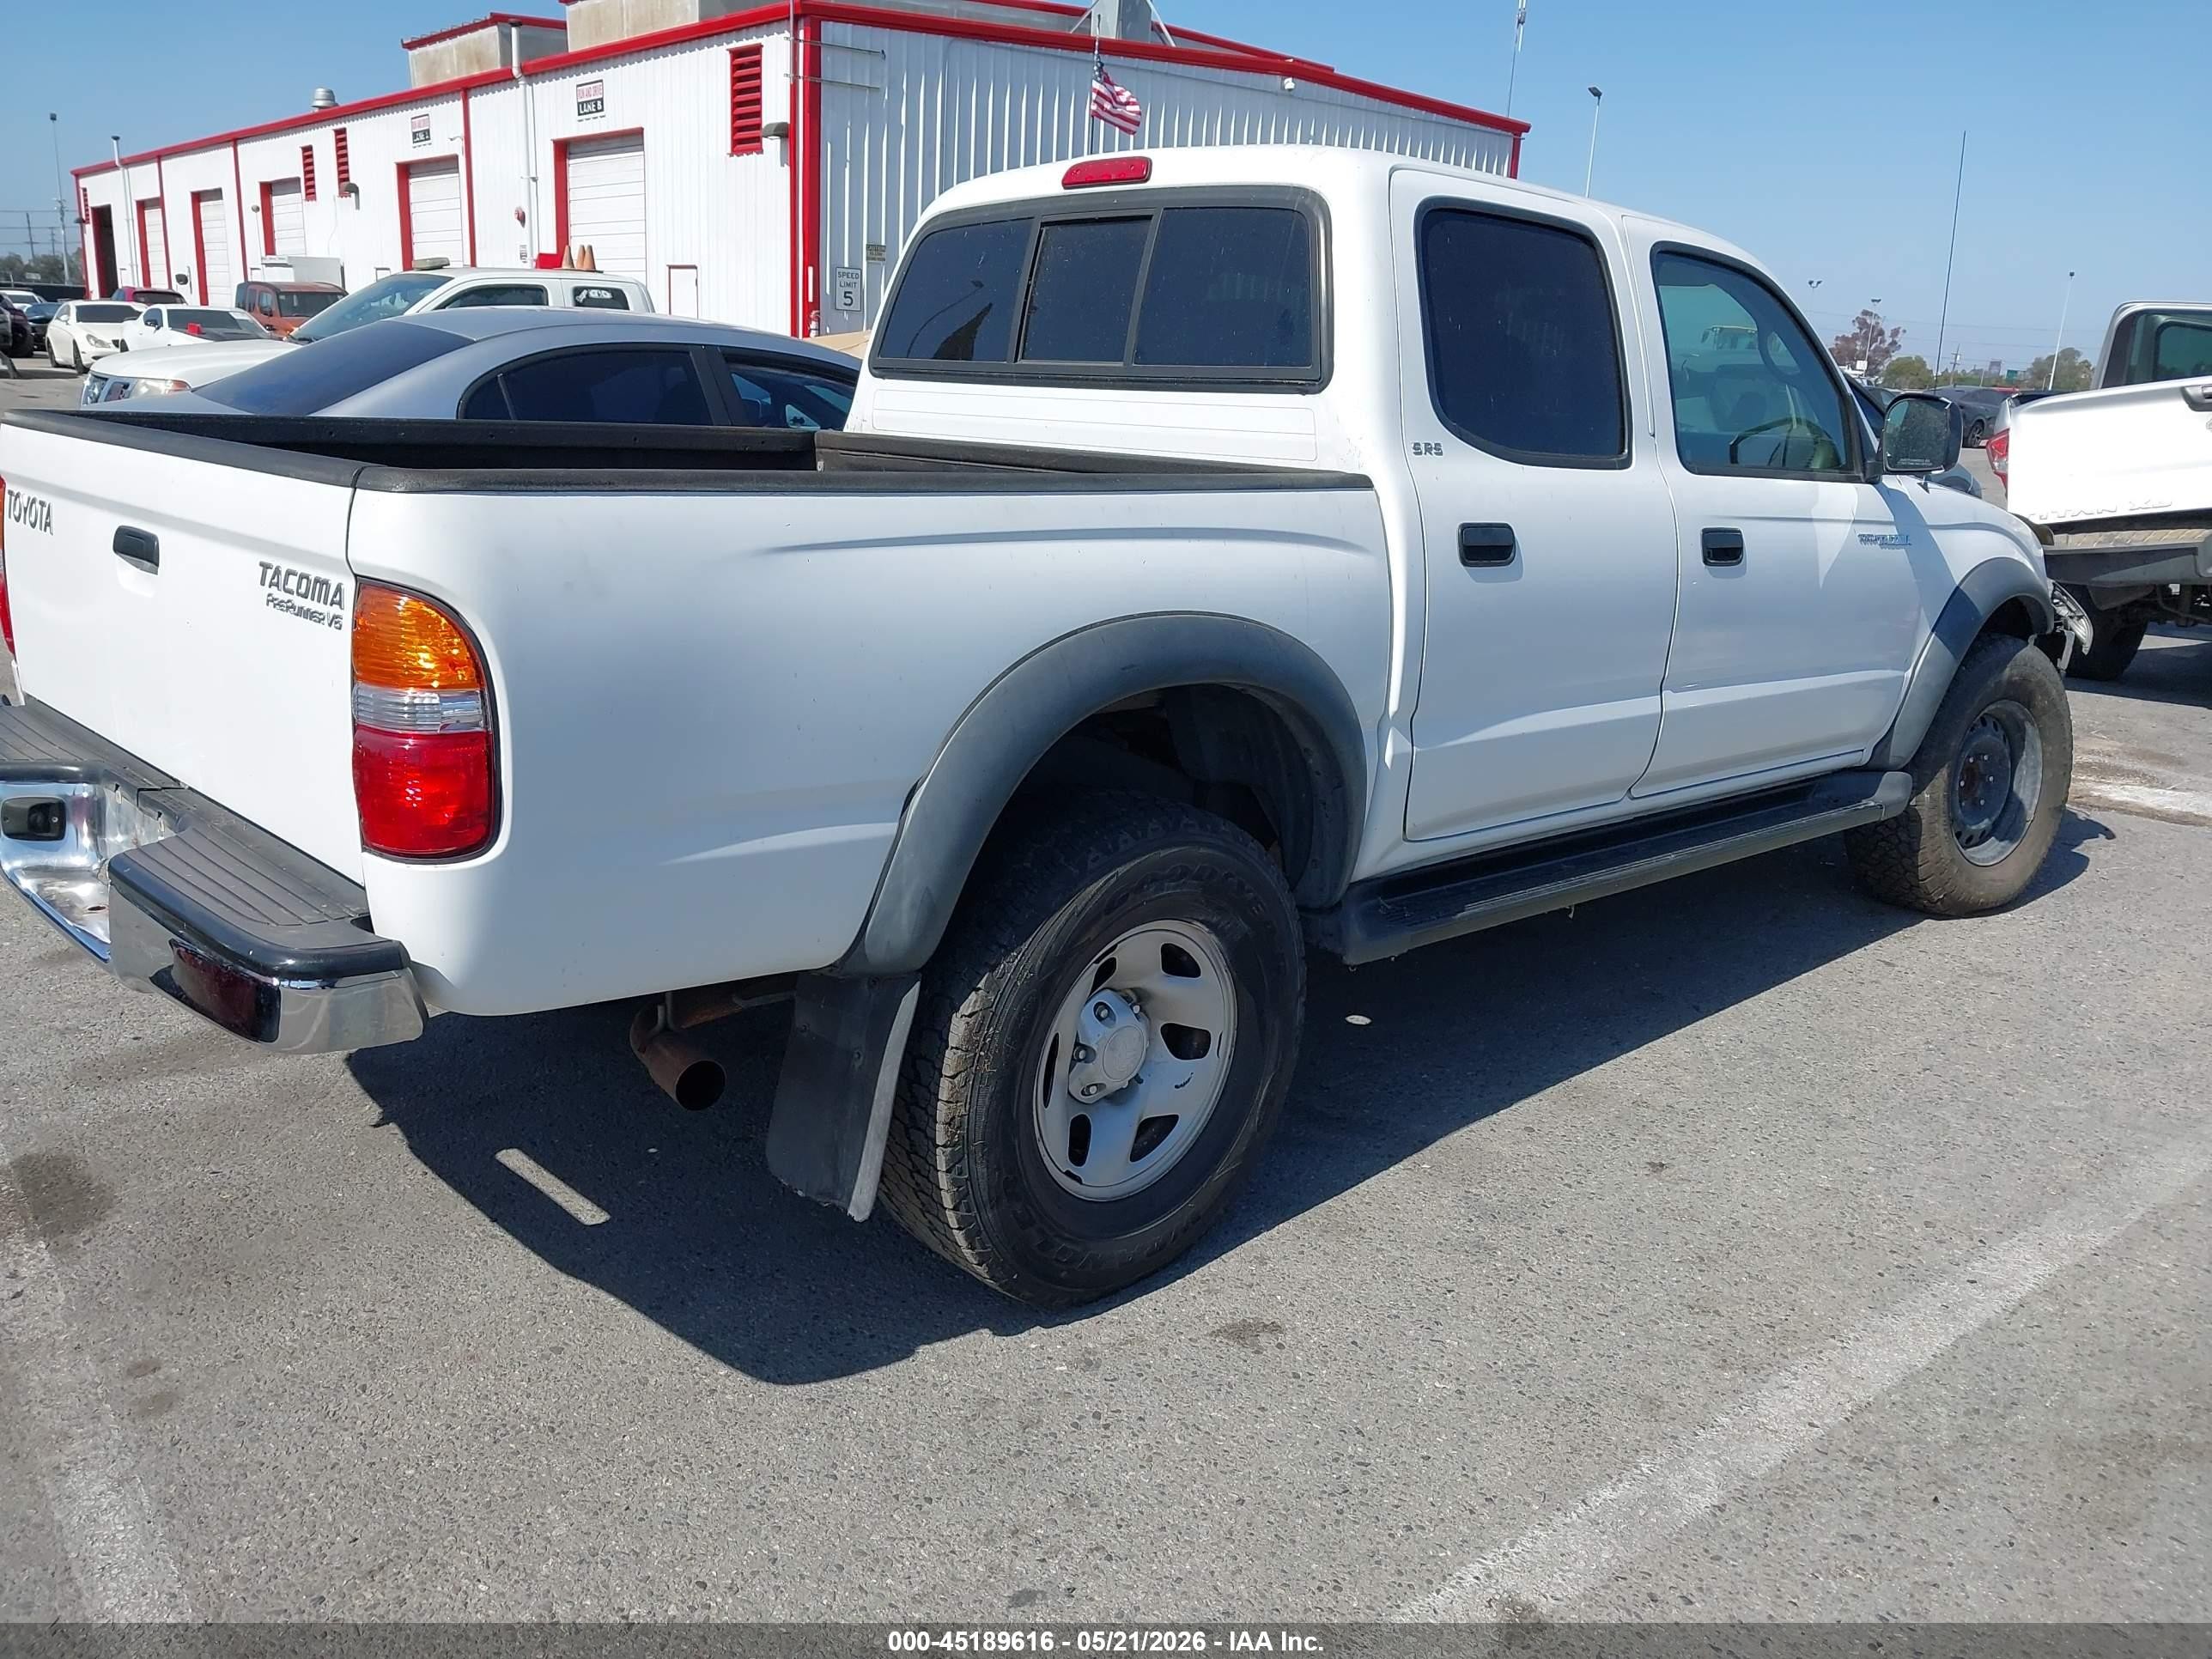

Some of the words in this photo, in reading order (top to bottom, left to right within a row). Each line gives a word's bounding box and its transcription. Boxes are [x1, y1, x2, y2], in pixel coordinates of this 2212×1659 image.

[579, 101, 597, 113] LANE
[838, 271, 860, 280] SPEED
[843, 290, 854, 307] 5
[8, 489, 53, 536] TOYOTA
[259, 561, 344, 611] TACOMA
[327, 611, 343, 630] V6
